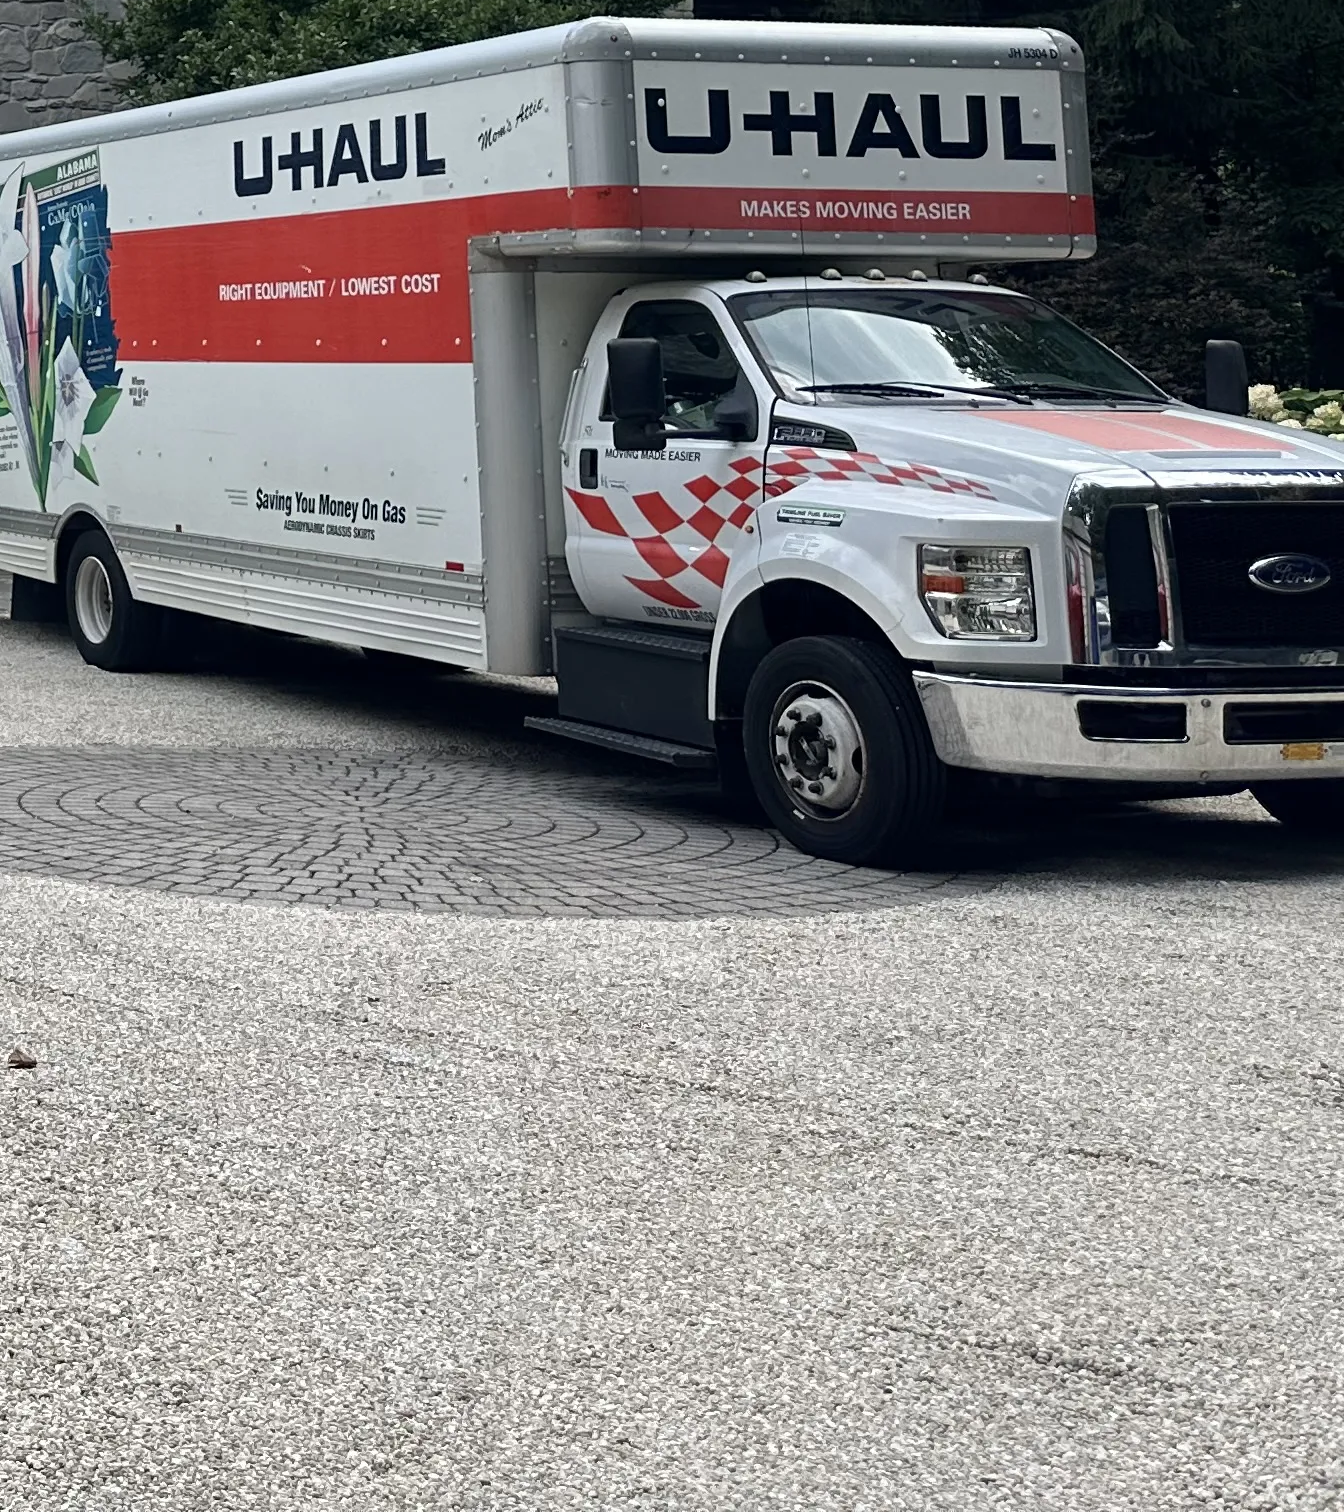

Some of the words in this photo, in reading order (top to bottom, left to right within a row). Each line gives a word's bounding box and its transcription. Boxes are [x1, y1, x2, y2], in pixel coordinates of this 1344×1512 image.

[1050, 49, 1058, 59] D
[644, 88, 1057, 161] U-HAUL
[234, 112, 446, 197] U-HAUL
[56, 153, 98, 181] ALABAMA
[741, 200, 810, 218] MAKES
[816, 201, 898, 219] MOVING
[903, 203, 971, 220] EASIER
[218, 284, 252, 301] RIGHT
[255, 280, 326, 300] EQUIPMENT
[341, 276, 397, 296] LOWEST
[401, 274, 441, 294] COST
[605, 448, 638, 459] MOVING
[641, 450, 665, 460] MADE
[668, 451, 701, 462] EASIER
[295, 491, 315, 514] You
[319, 494, 358, 523] Money
[362, 498, 378, 521] On
[382, 500, 406, 524] Gas
[326, 524, 352, 538] CHASSIS
[353, 527, 375, 540] SKIRTS
[1273, 562, 1316, 584] Ford
